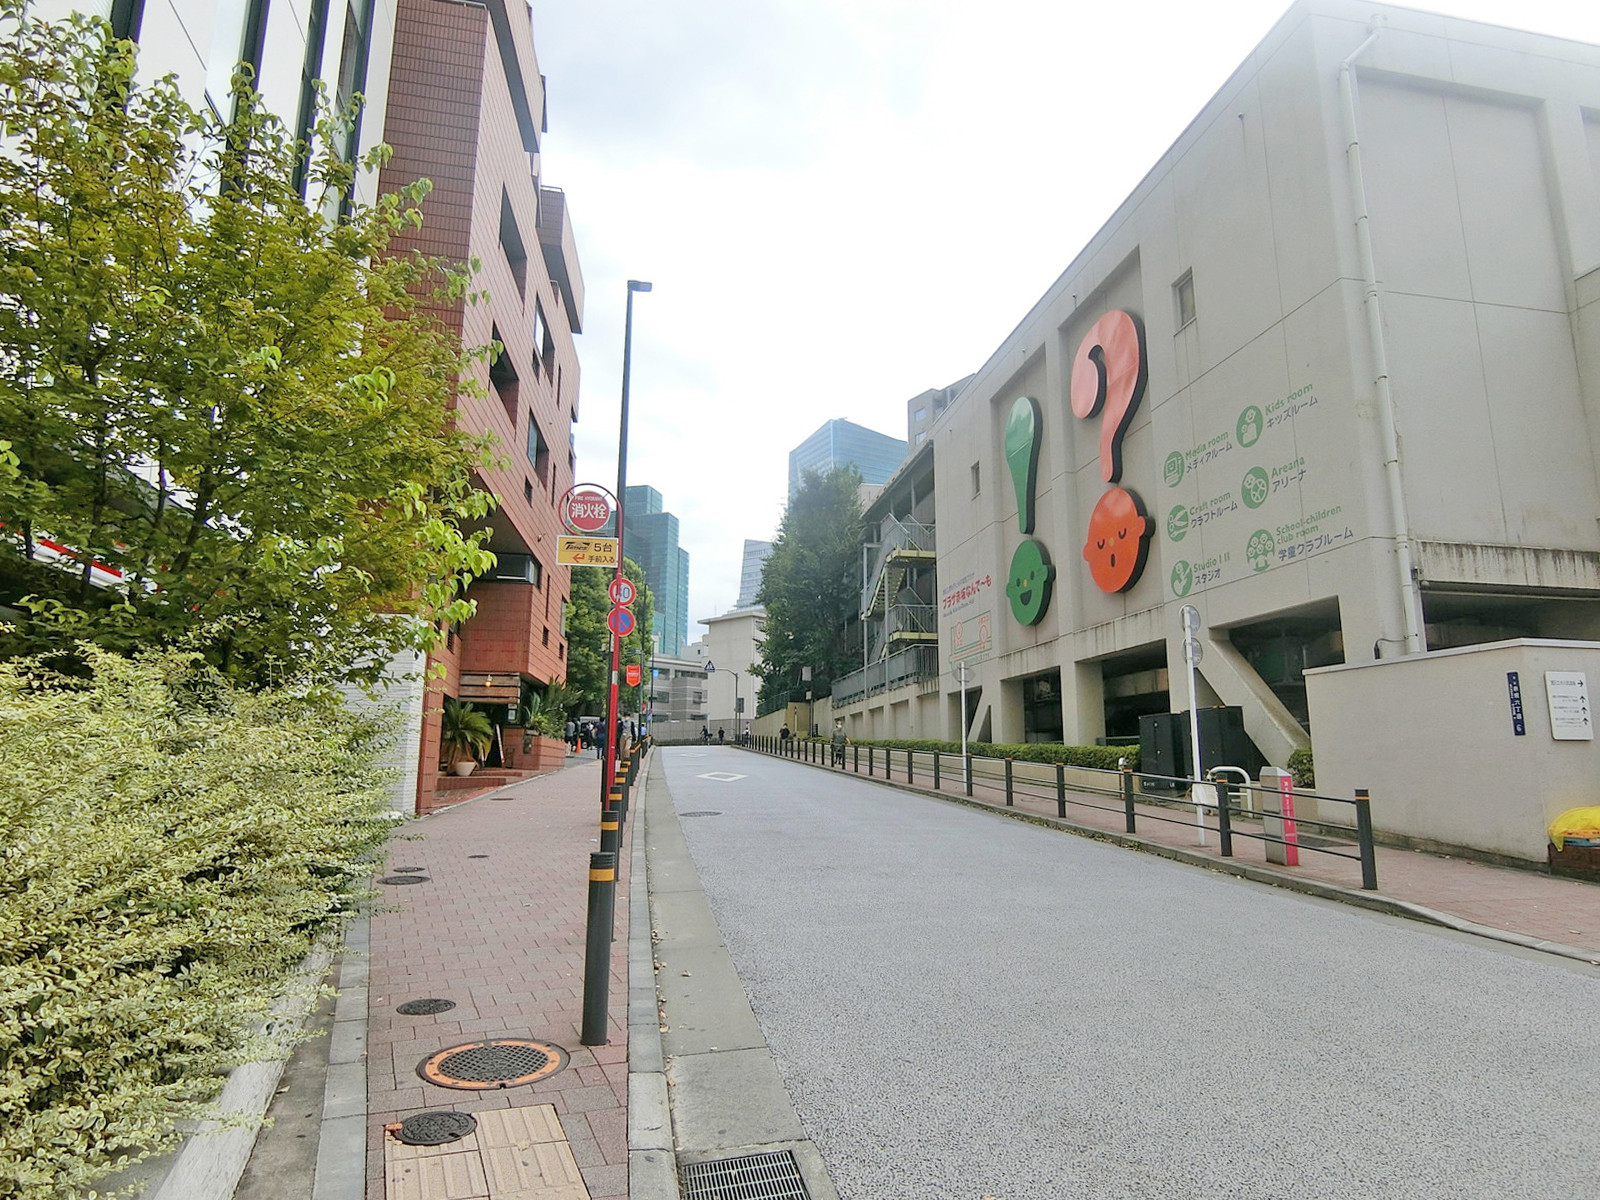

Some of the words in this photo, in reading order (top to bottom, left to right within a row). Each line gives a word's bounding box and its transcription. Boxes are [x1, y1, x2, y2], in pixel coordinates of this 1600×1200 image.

[1264, 399, 1285, 417] Kids
[1287, 383, 1313, 404] room
[1266, 395, 1318, 429] キッズルーム
[1185, 438, 1206, 460] Media
[1207, 431, 1229, 449] room
[1186, 441, 1233, 474] メディアルーム
[1271, 456, 1306, 479] Areana
[1272, 468, 1307, 493] アリーナ
[571, 502, 607, 519] 消火栓
[1189, 500, 1209, 516] Craft
[1210, 492, 1231, 508] room
[1190, 500, 1238, 529] クラフトルーム
[1276, 530, 1295, 545] club
[1295, 524, 1319, 542] room
[1278, 526, 1354, 563] 学童クラブルーム
[594, 542, 613, 553] 5台
[1193, 558, 1218, 574] Studio
[1194, 568, 1222, 586] スタジオ
